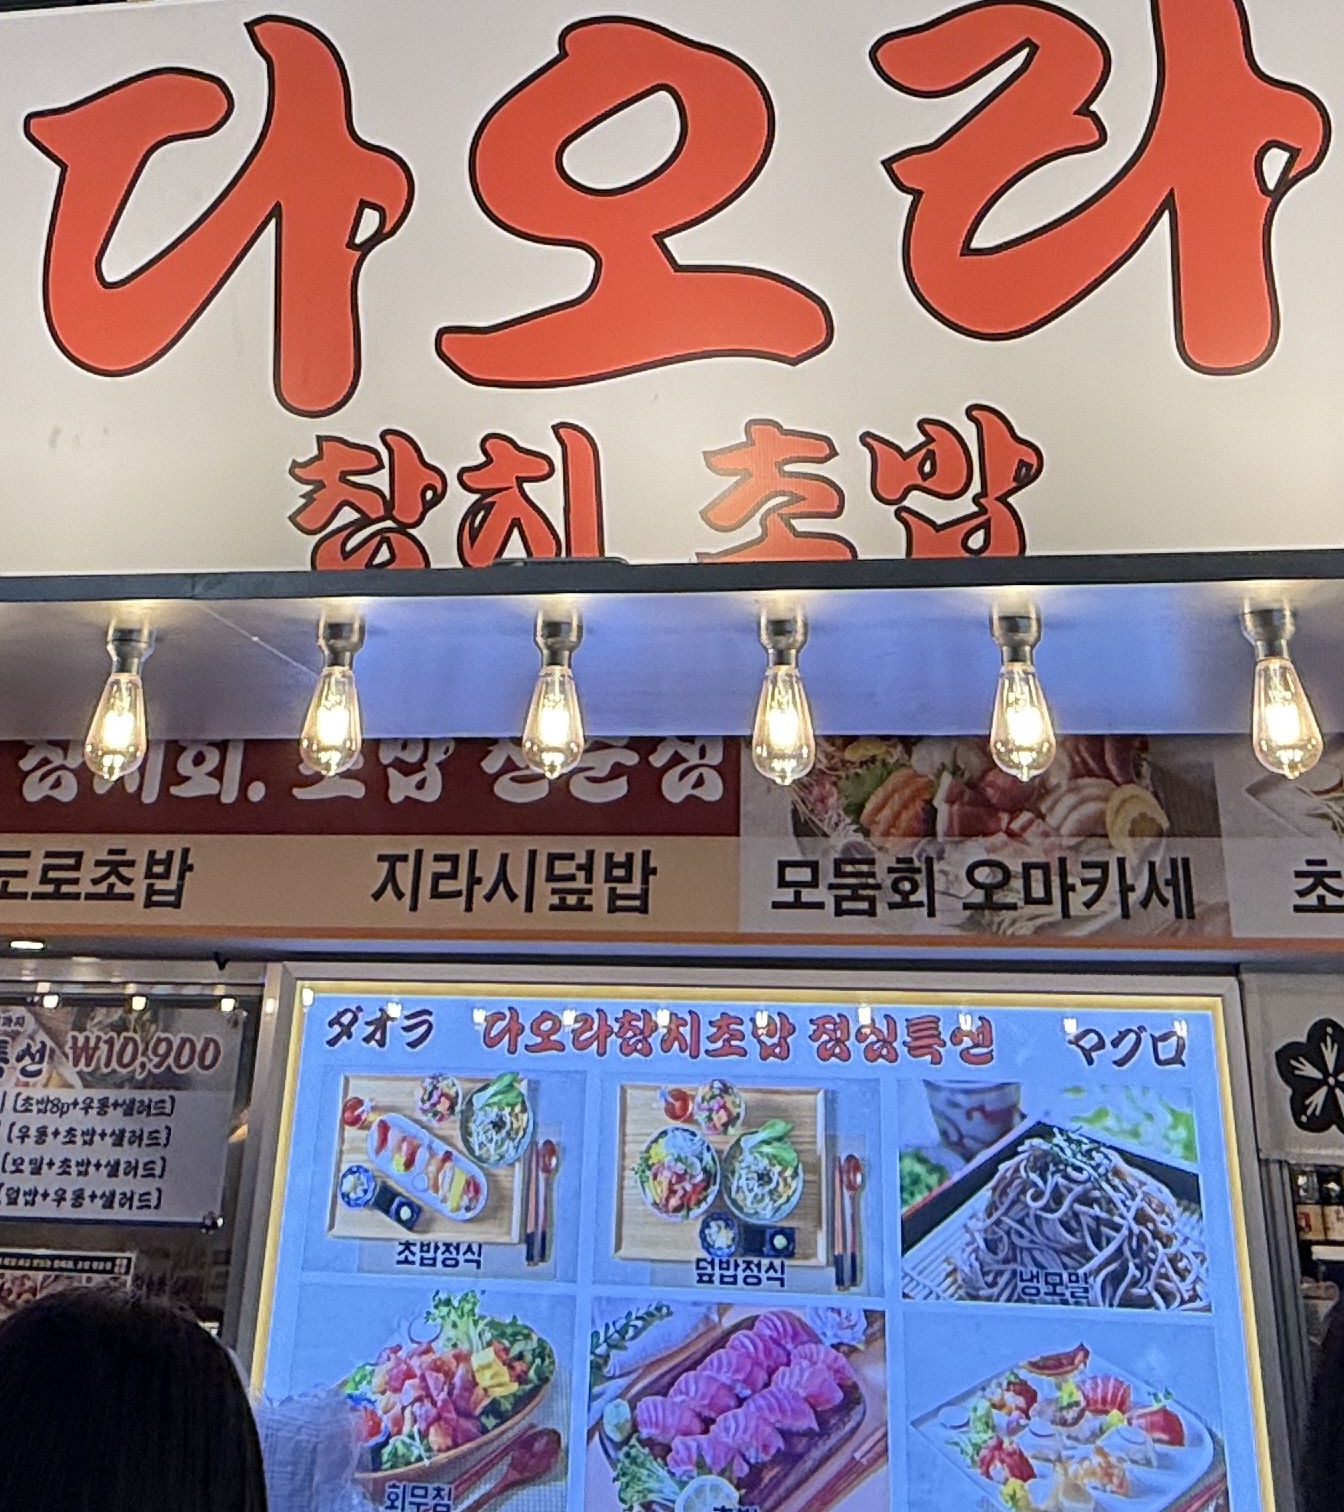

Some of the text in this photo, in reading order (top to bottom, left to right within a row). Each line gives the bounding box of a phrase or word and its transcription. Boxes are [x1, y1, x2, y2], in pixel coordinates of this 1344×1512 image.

[288, 403, 1044, 570] 참치 초밥
[370, 848, 658, 915] 지라시덮밥
[771, 856, 1197, 921] 모둠회 오마카세
[324, 1004, 435, 1050] ダオラ
[1066, 1026, 1189, 1068] マグロ
[394, 1239, 485, 1272] 초밥정식
[694, 1256, 787, 1289] 덮밥정식
[1018, 1270, 1090, 1300] 냉모밀
[383, 1482, 453, 1512] 회무침
